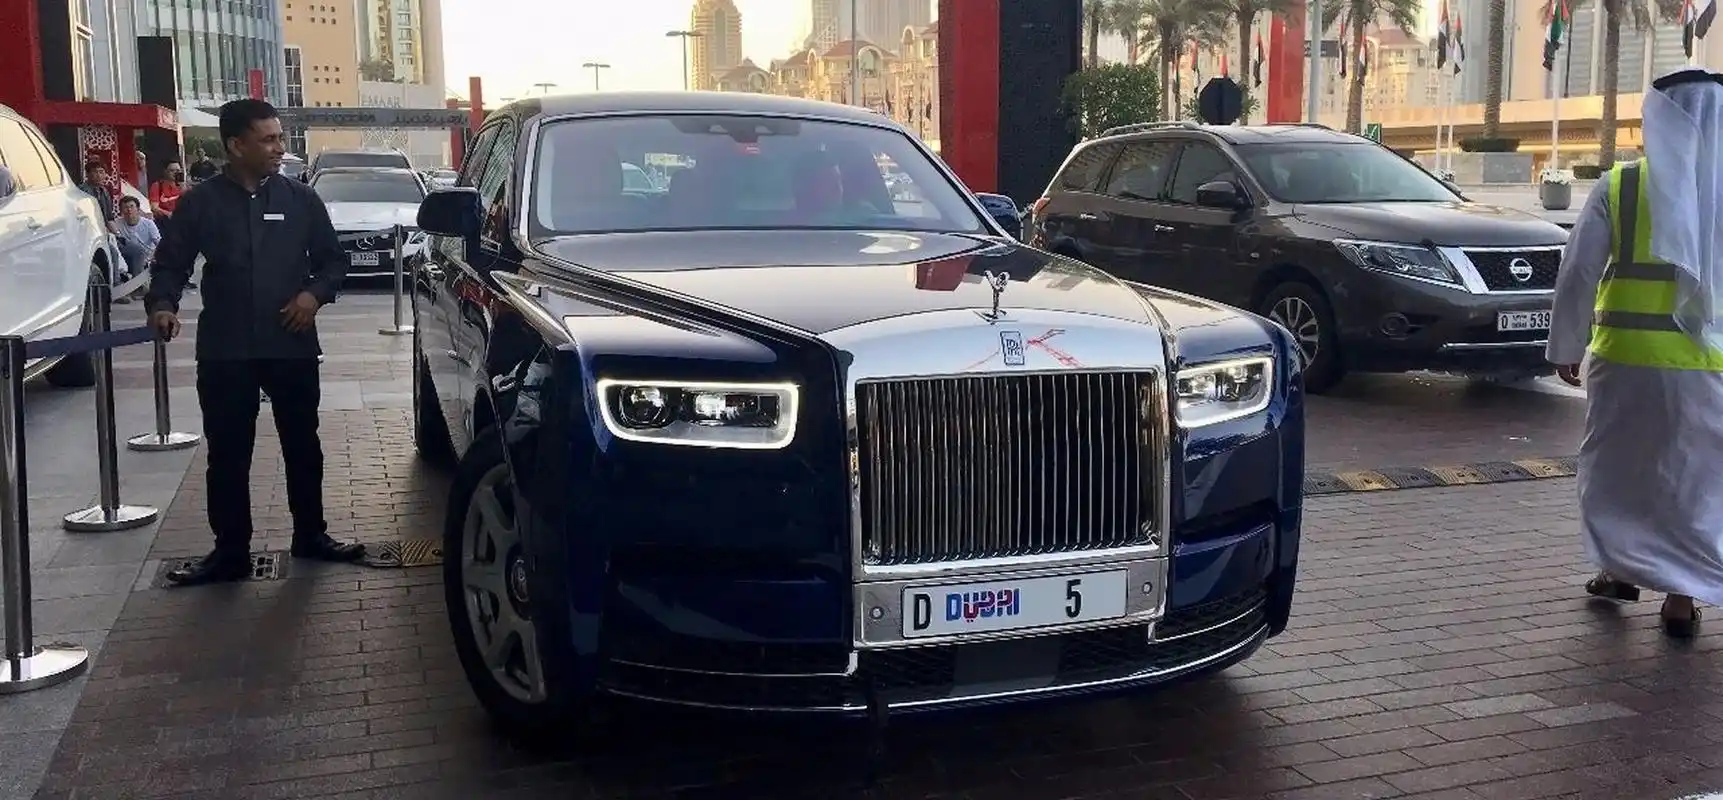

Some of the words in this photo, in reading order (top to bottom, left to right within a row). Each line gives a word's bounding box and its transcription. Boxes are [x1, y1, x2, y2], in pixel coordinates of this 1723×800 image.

[913, 594, 931, 630] D
[946, 588, 1020, 622] DUBAI
[1065, 579, 1082, 618] 5
